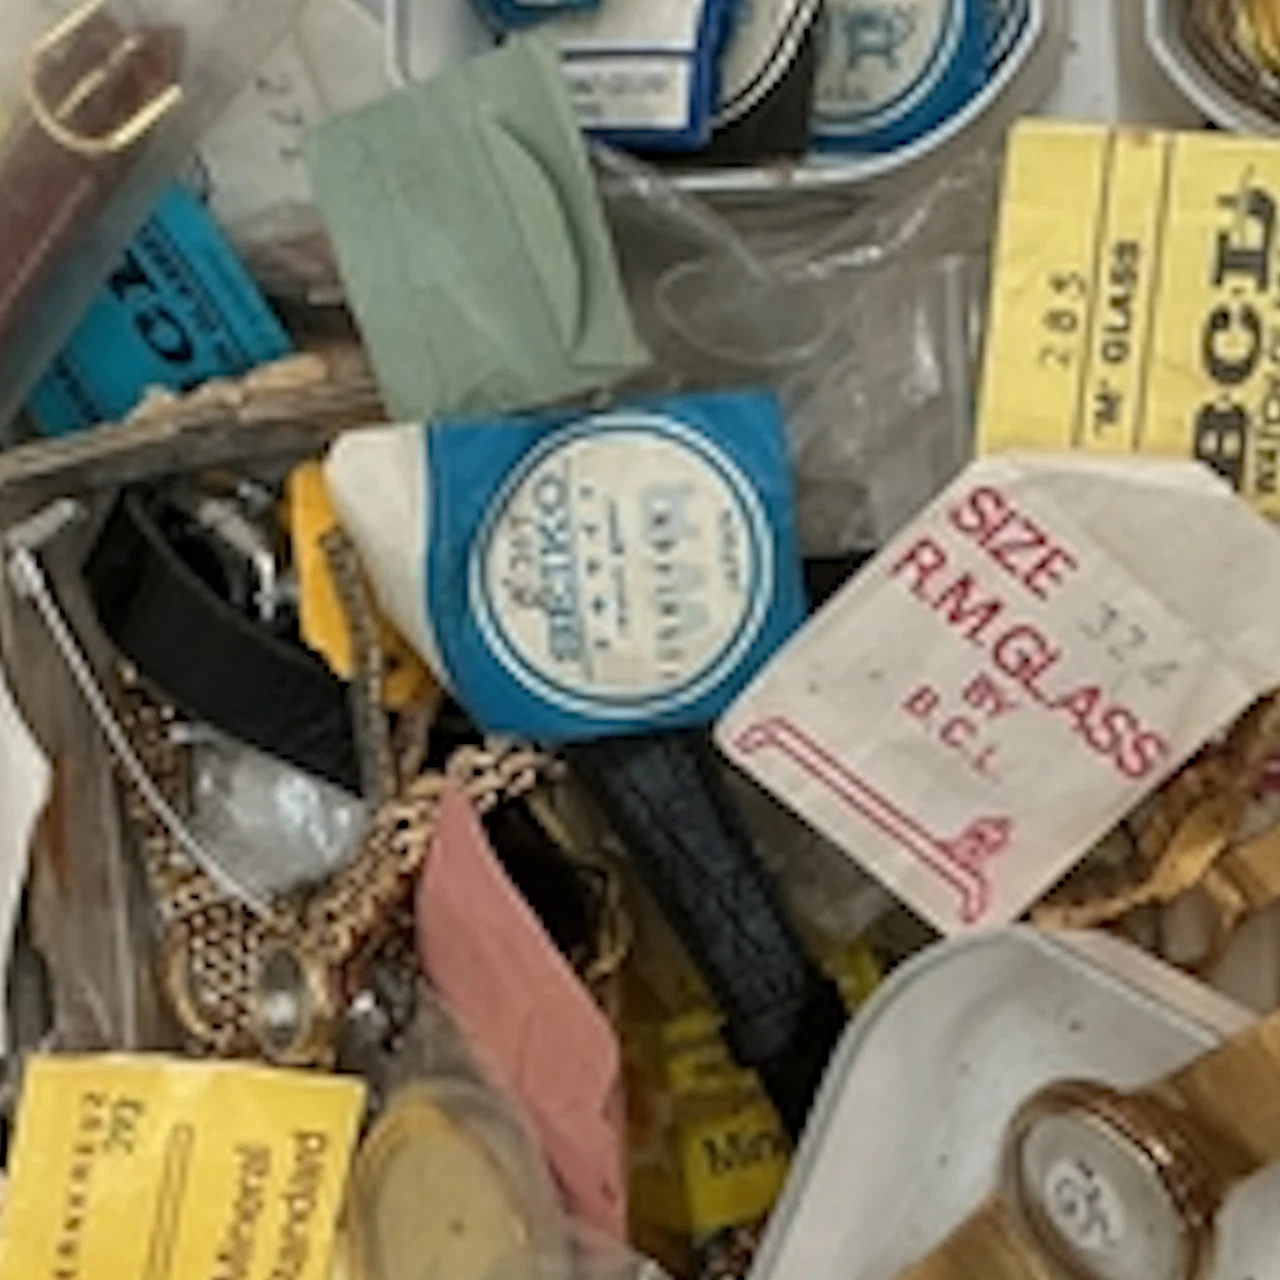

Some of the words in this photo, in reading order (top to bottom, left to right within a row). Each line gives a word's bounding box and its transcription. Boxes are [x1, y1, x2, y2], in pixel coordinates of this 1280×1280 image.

[1102, 240, 1140, 364] GLASS
[533, 471, 584, 663] SEIKO
[949, 485, 1079, 601] SIZE
[962, 672, 1015, 719] BY
